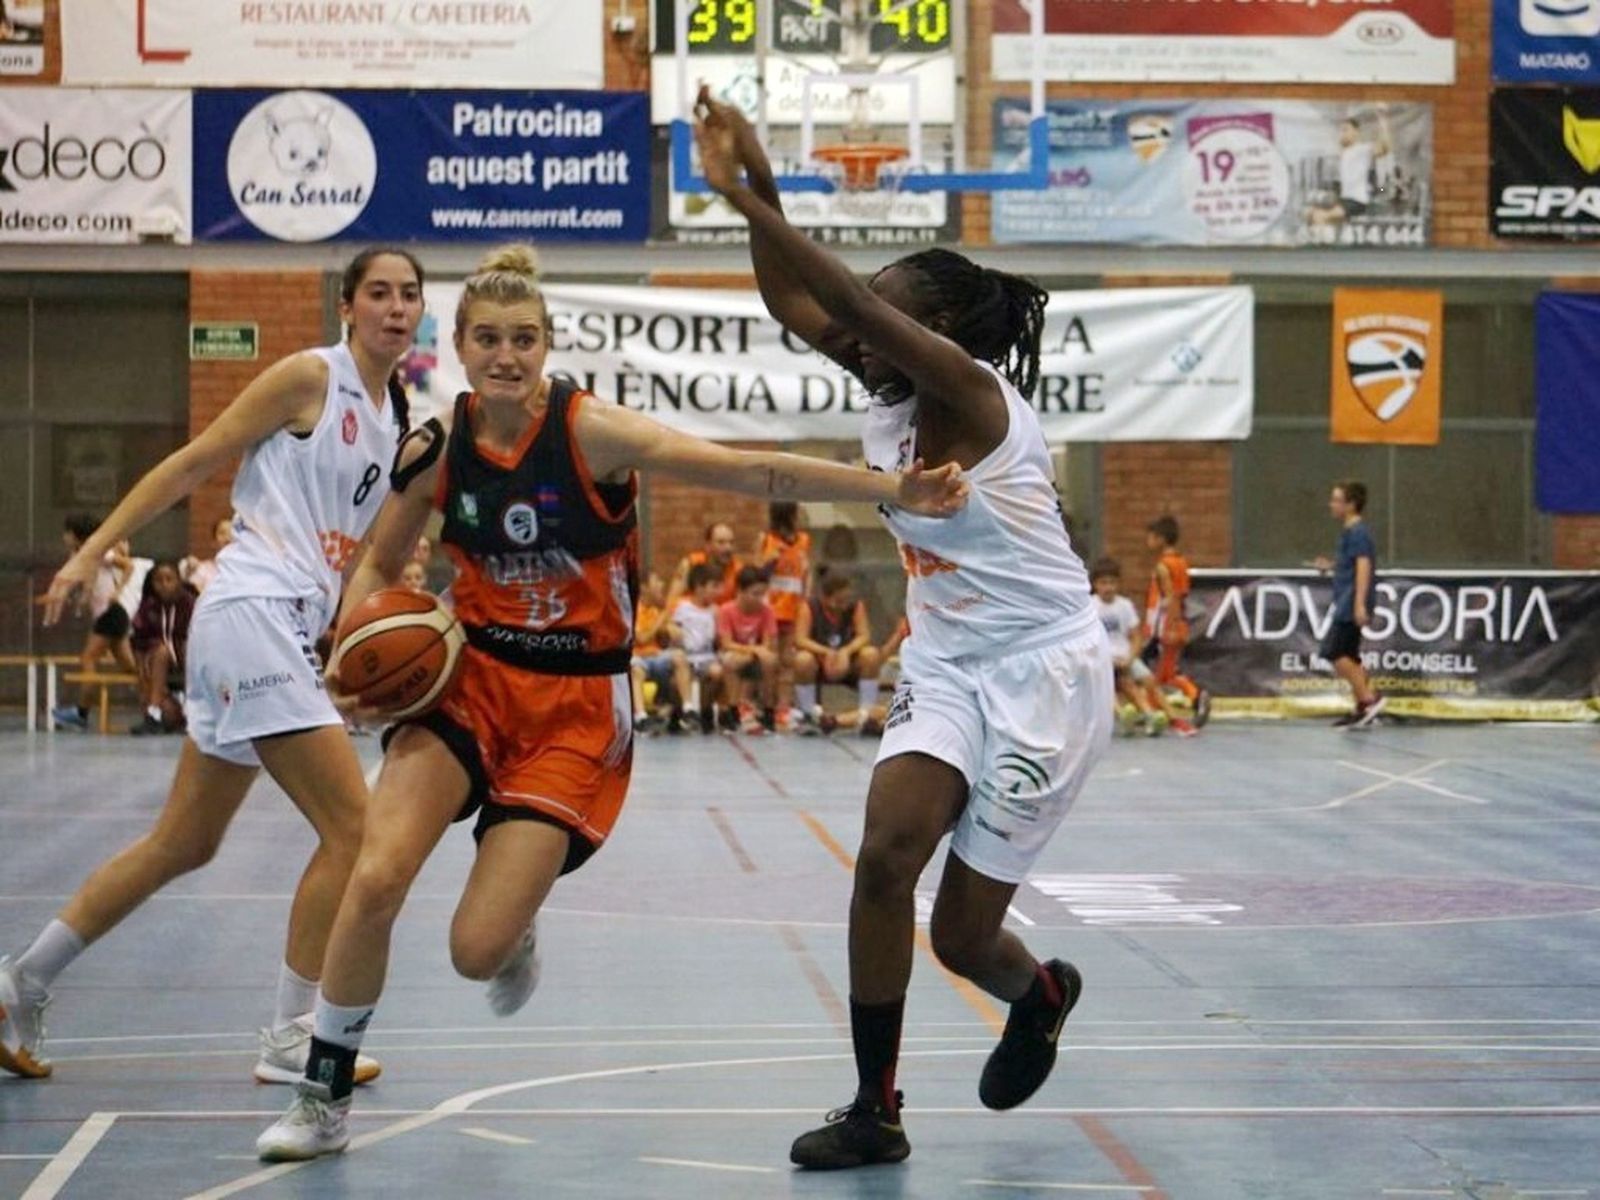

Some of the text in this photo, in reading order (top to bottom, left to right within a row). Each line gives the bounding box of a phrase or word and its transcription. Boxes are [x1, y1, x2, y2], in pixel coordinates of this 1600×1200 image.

[240, 2, 384, 25] RESTAURANT
[409, 2, 532, 25] CAFETERIA
[687, 0, 756, 43] 39
[879, 0, 949, 43] 40
[453, 102, 603, 137] Patrocina
[427, 150, 629, 192] aquest partit
[1197, 149, 1236, 184] 19
[240, 180, 366, 208] Can Serrat
[431, 206, 624, 229] www.canserrat.com
[353, 462, 381, 507] 8
[1205, 583, 1559, 642] ADVSORIA
[1280, 652, 1306, 671] EL
[1383, 650, 1477, 673] CONSELL
